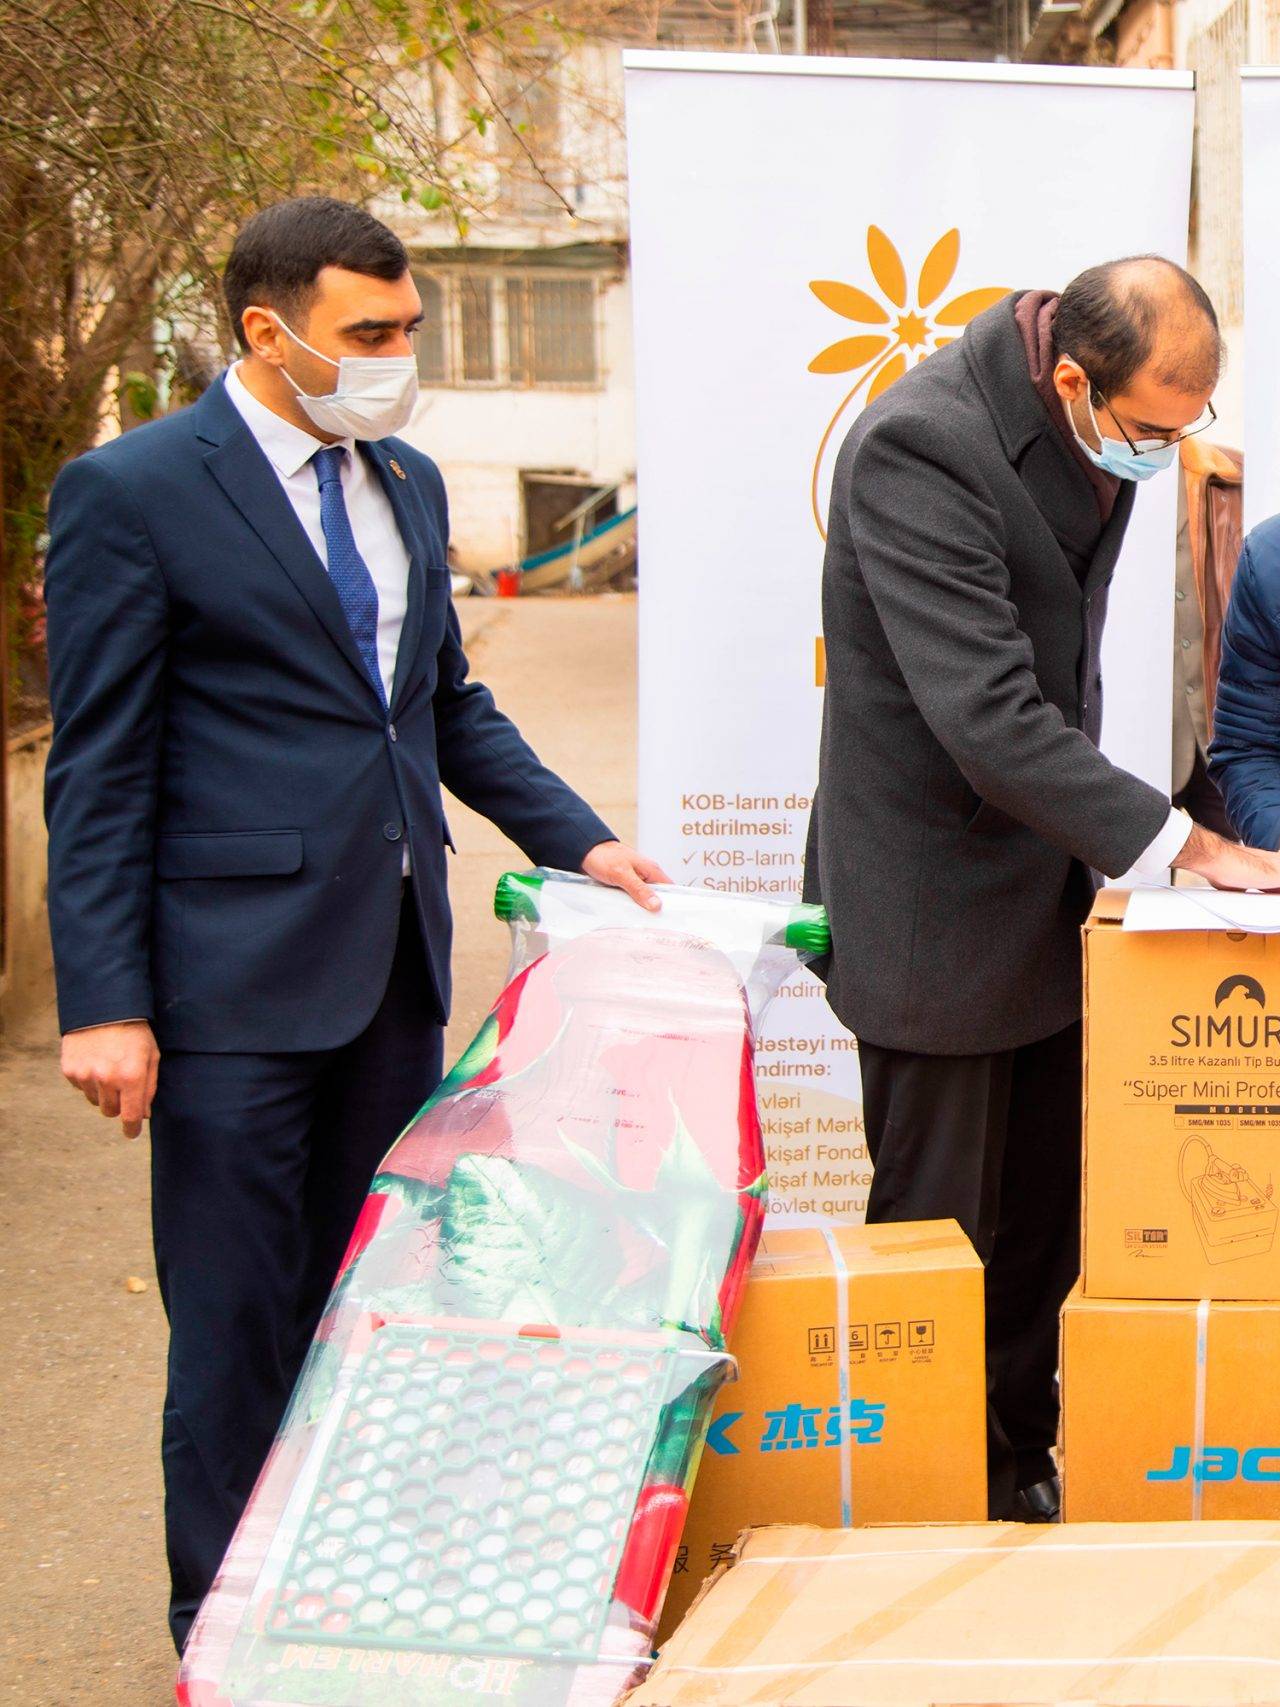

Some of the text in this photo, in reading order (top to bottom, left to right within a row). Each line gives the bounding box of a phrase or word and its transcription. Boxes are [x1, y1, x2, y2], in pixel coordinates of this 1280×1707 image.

[682, 794, 778, 810] KOB-ların
[682, 819, 792, 836] etdirilməsi:
[703, 850, 795, 867] KOB-ların
[1149, 1056, 1168, 1066] 3.5
[1171, 1056, 1195, 1066] litre
[1198, 1056, 1241, 1067] Kazanlı
[1193, 1080, 1230, 1098] Mini
